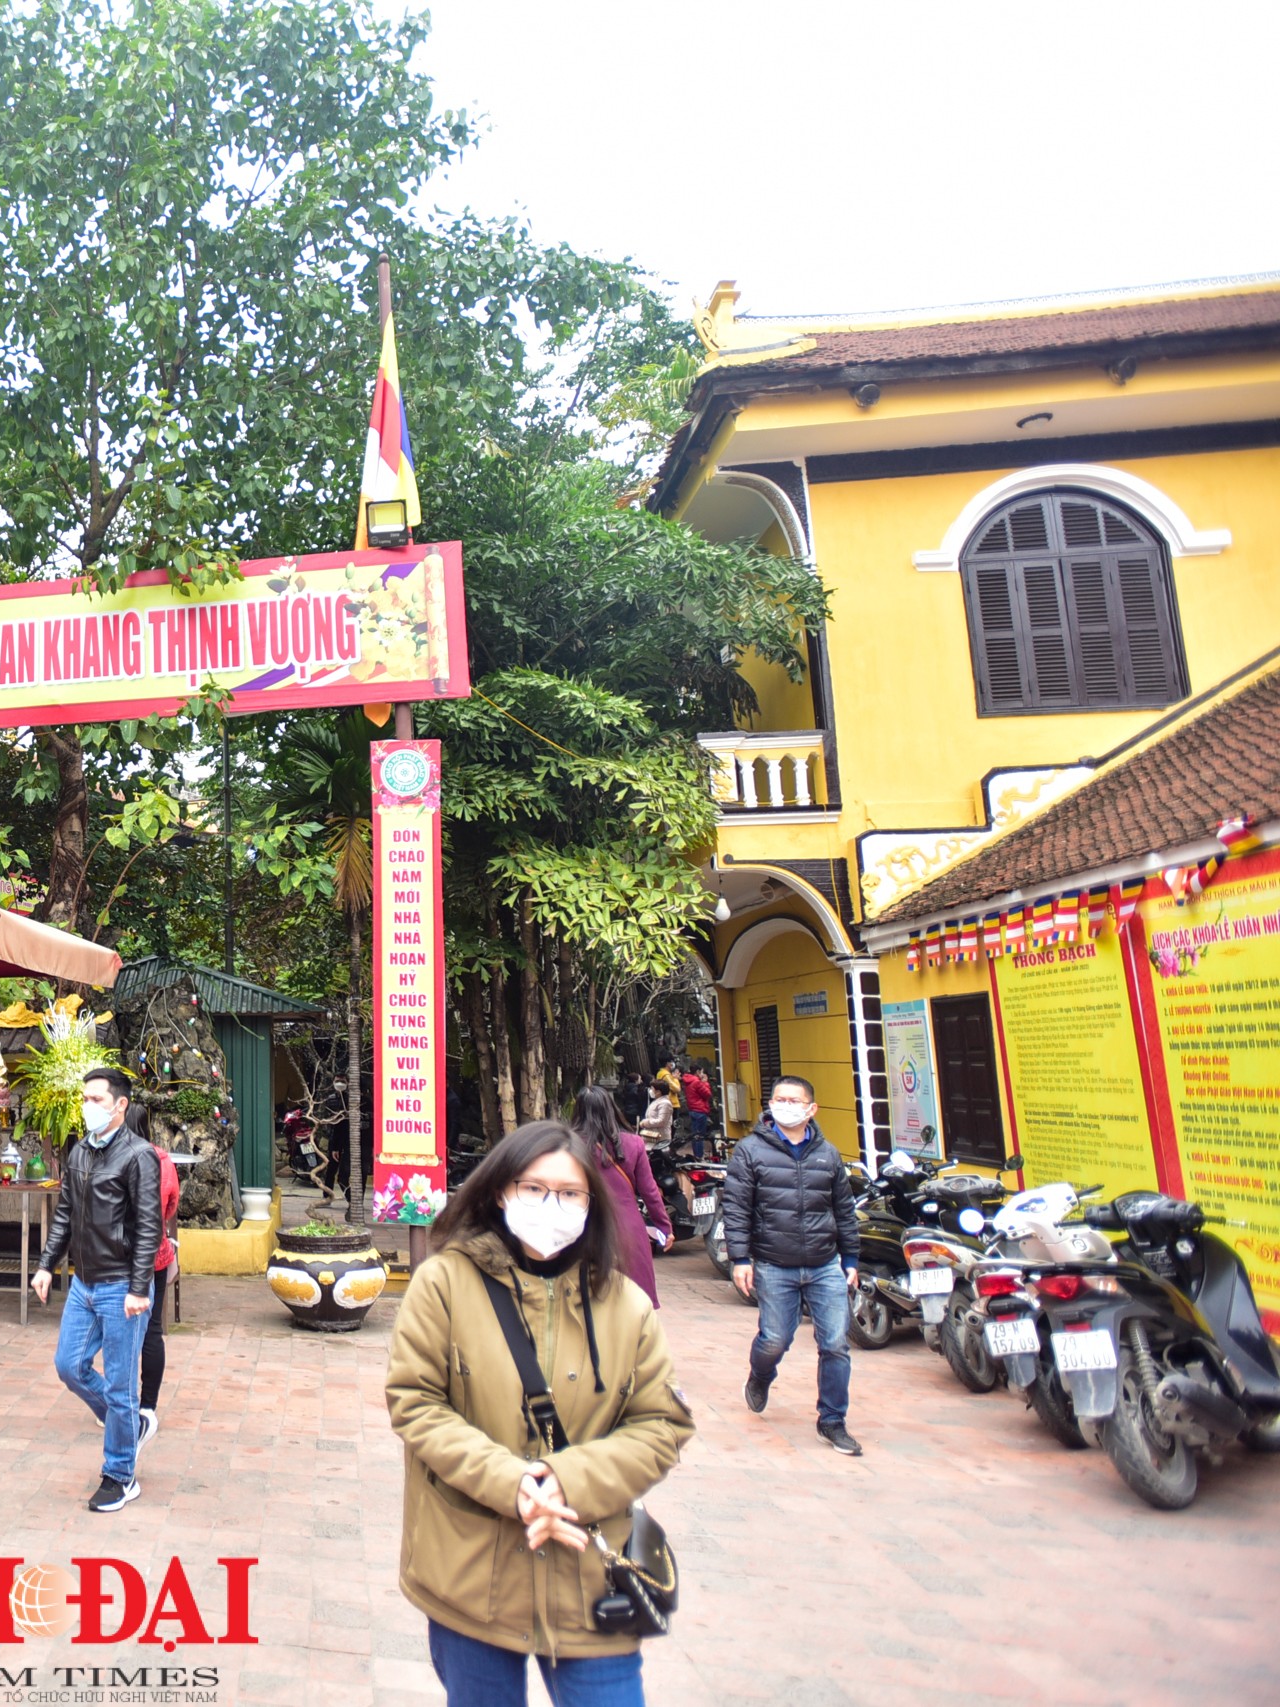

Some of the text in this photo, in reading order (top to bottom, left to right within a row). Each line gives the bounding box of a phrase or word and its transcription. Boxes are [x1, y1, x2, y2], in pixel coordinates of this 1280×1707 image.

[43, 612, 143, 680] KHANG
[147, 603, 242, 688] THỊNH
[247, 592, 358, 680] VƯỢNG
[1012, 943, 1096, 969] THÔNG BẠCH
[1173, 926, 1191, 948] CÁC
[1192, 922, 1218, 945] KHÓA
[1232, 915, 1261, 939] XUÂN
[386, 828, 432, 1134] ĐÓN CHÀO NĂM MỚI NHÀ NHÀ HOAN HỶ CHÚC TỤNG MỪNG VUI KHẮP NẺO ĐƯỜNG
